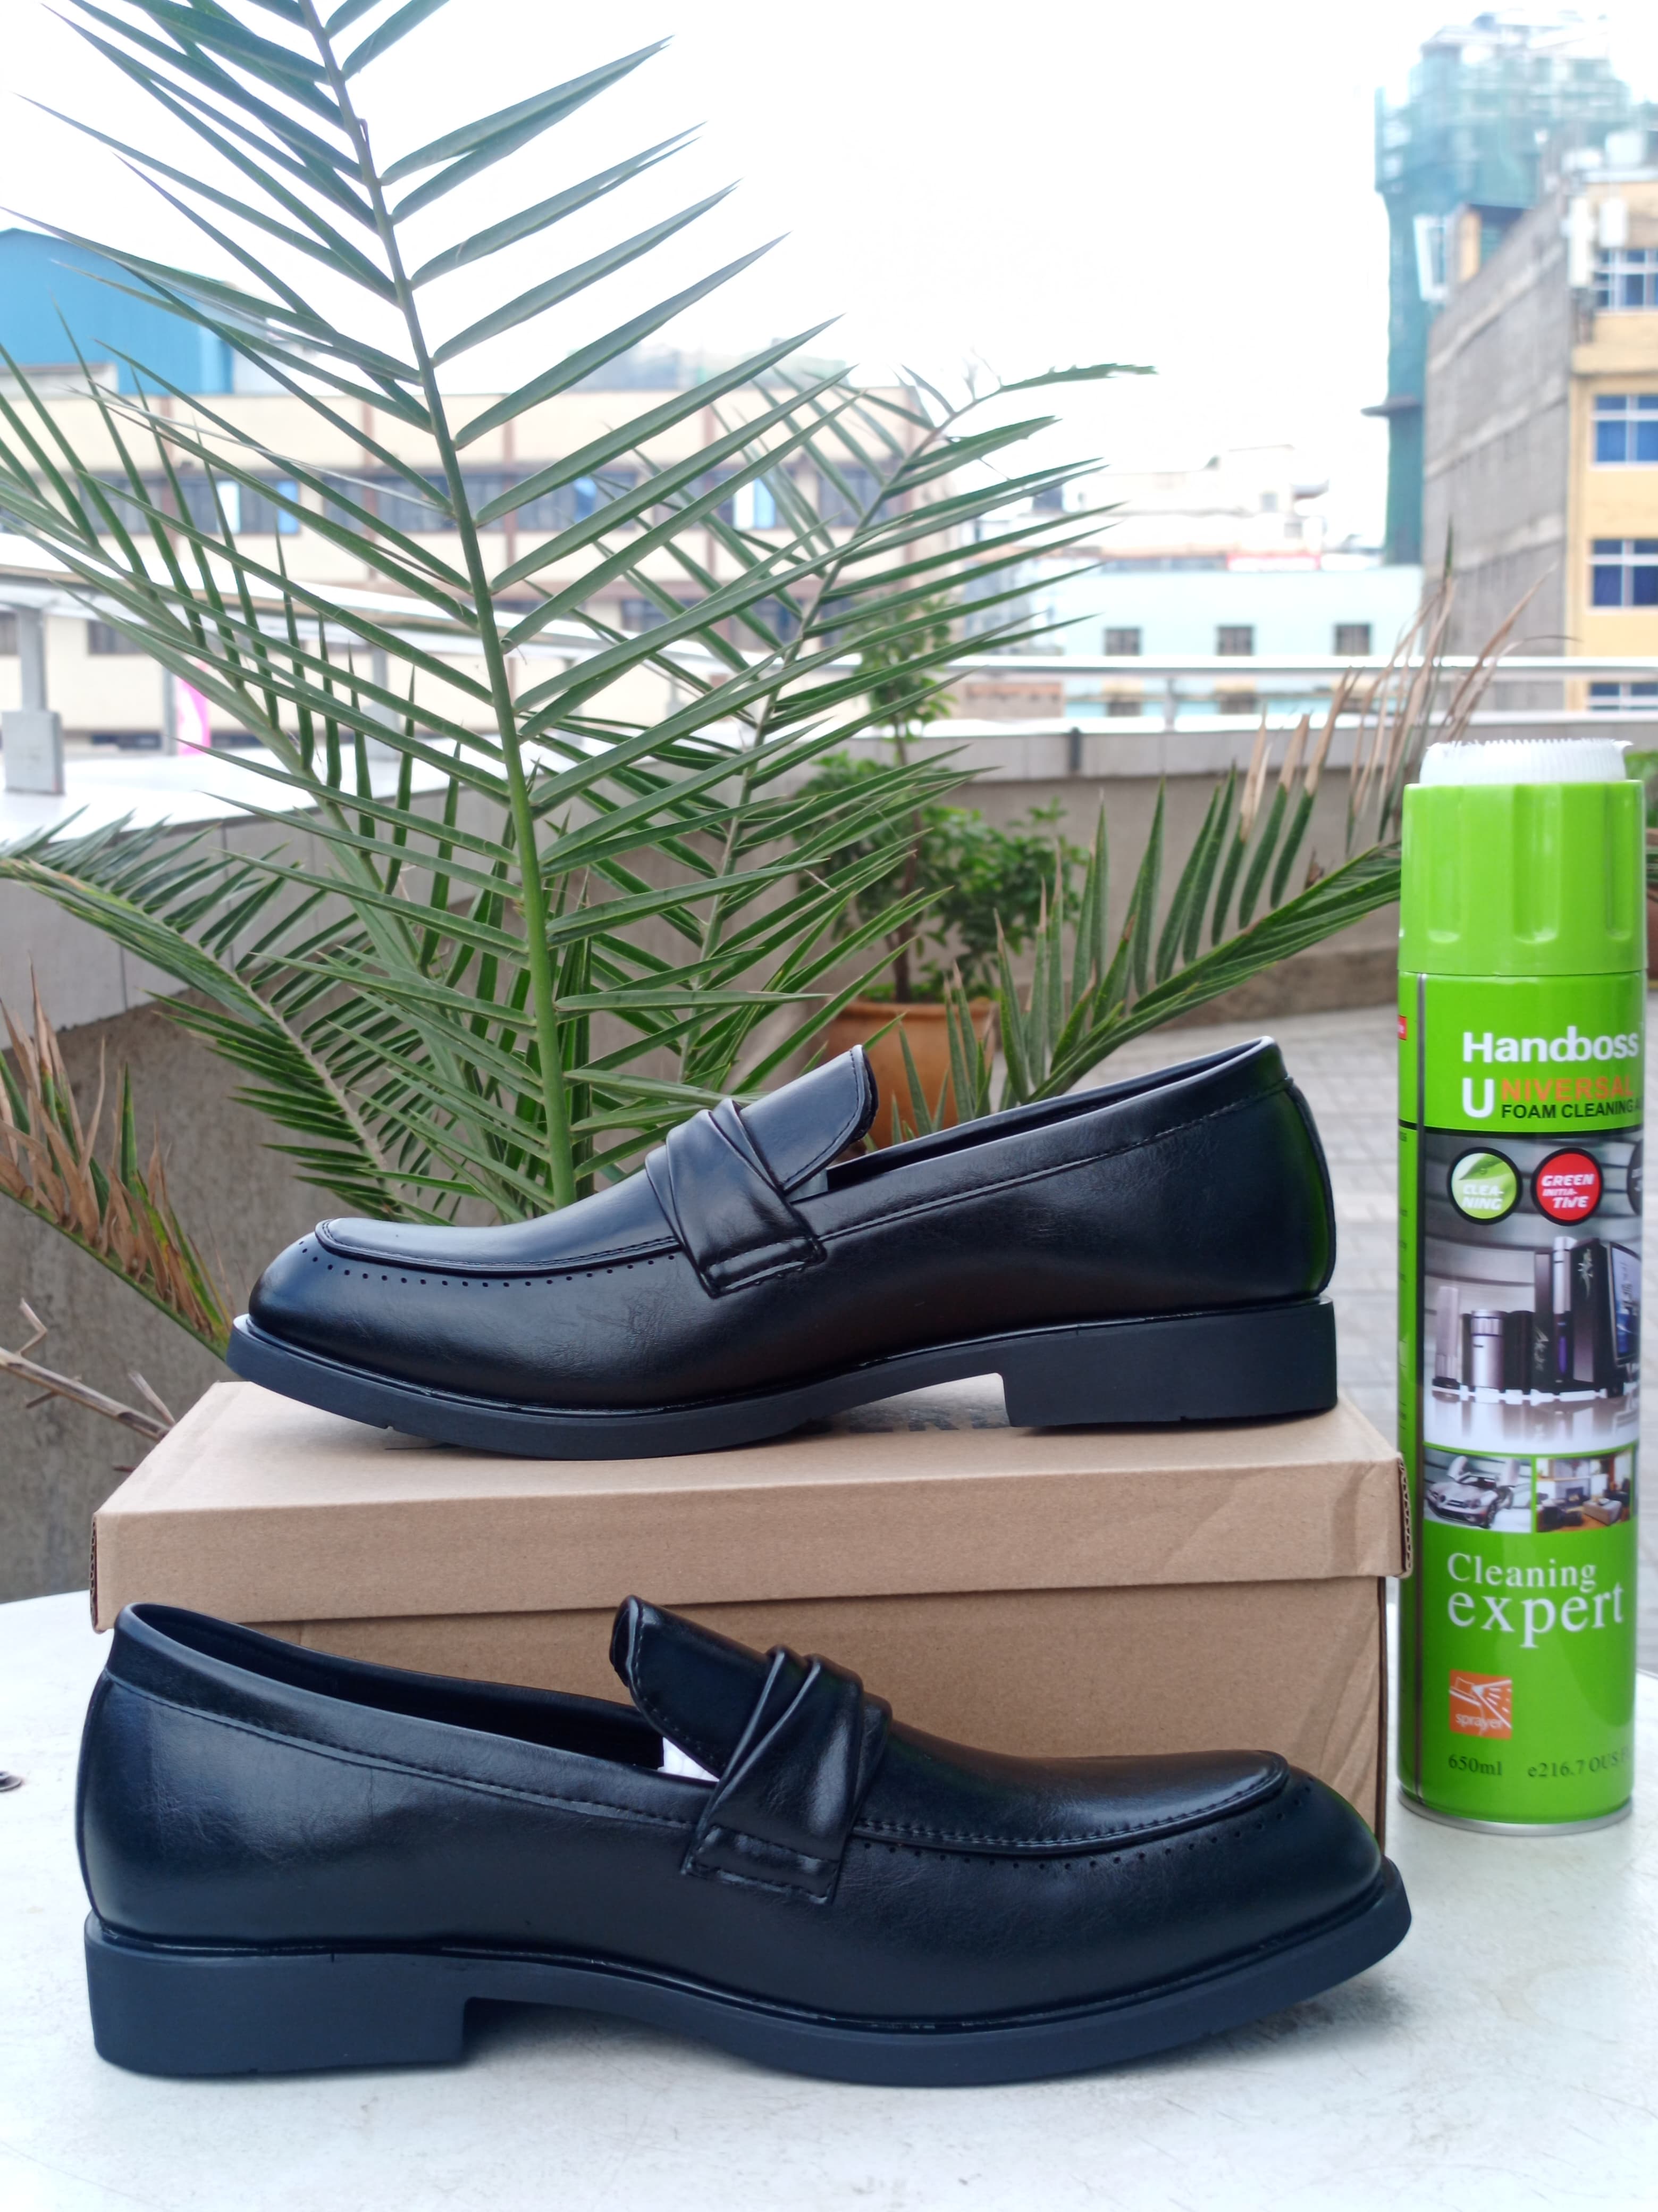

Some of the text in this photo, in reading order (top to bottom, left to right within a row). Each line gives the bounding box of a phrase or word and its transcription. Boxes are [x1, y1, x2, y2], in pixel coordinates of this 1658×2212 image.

[1462, 1026, 1638, 1063] Handboss
[1501, 1104, 1556, 1118] FOAM
[1561, 1099, 1634, 1118] CLEANING
[1542, 1174, 1594, 1186] GREEN
[1462, 1197, 1503, 1210] NING
[1553, 1196, 1589, 1209] TIVE
[1447, 1553, 1597, 1593] Cleaning
[1447, 1582, 1625, 1648] expert
[1455, 1713, 1503, 1733] sprayer
[1449, 1754, 1503, 1776] 650ml
